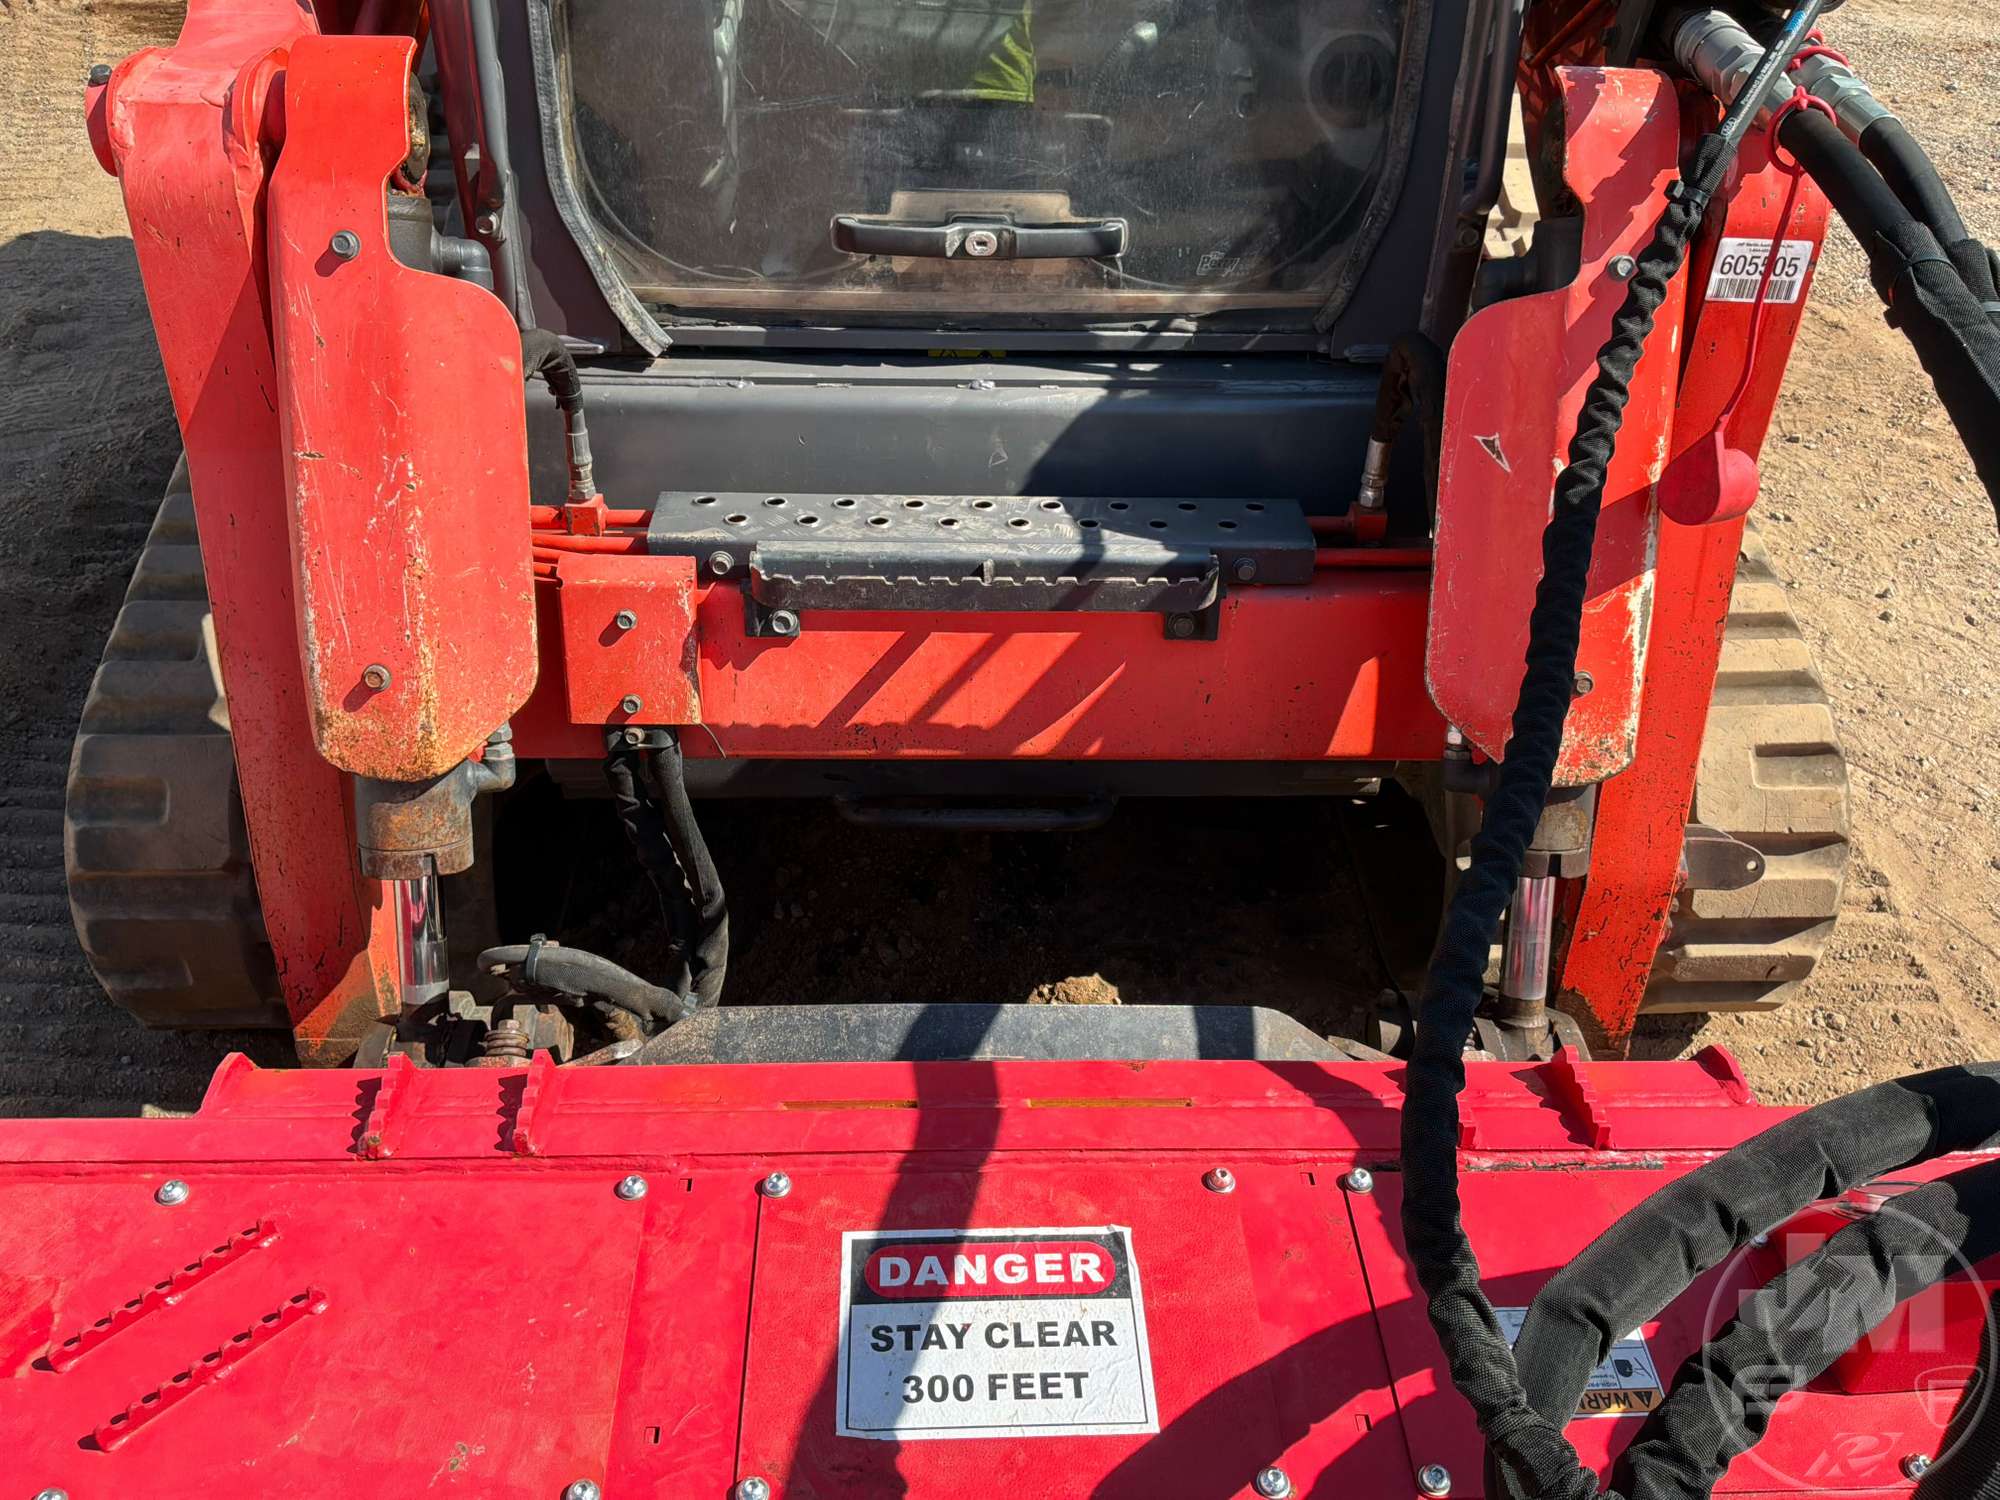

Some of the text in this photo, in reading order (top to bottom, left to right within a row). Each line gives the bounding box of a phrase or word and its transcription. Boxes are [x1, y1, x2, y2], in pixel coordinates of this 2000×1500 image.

[878, 1252, 1105, 1287] DANGER
[871, 1320, 1118, 1352] STAY CLEAR
[902, 1371, 1089, 1403] 300 FEET
